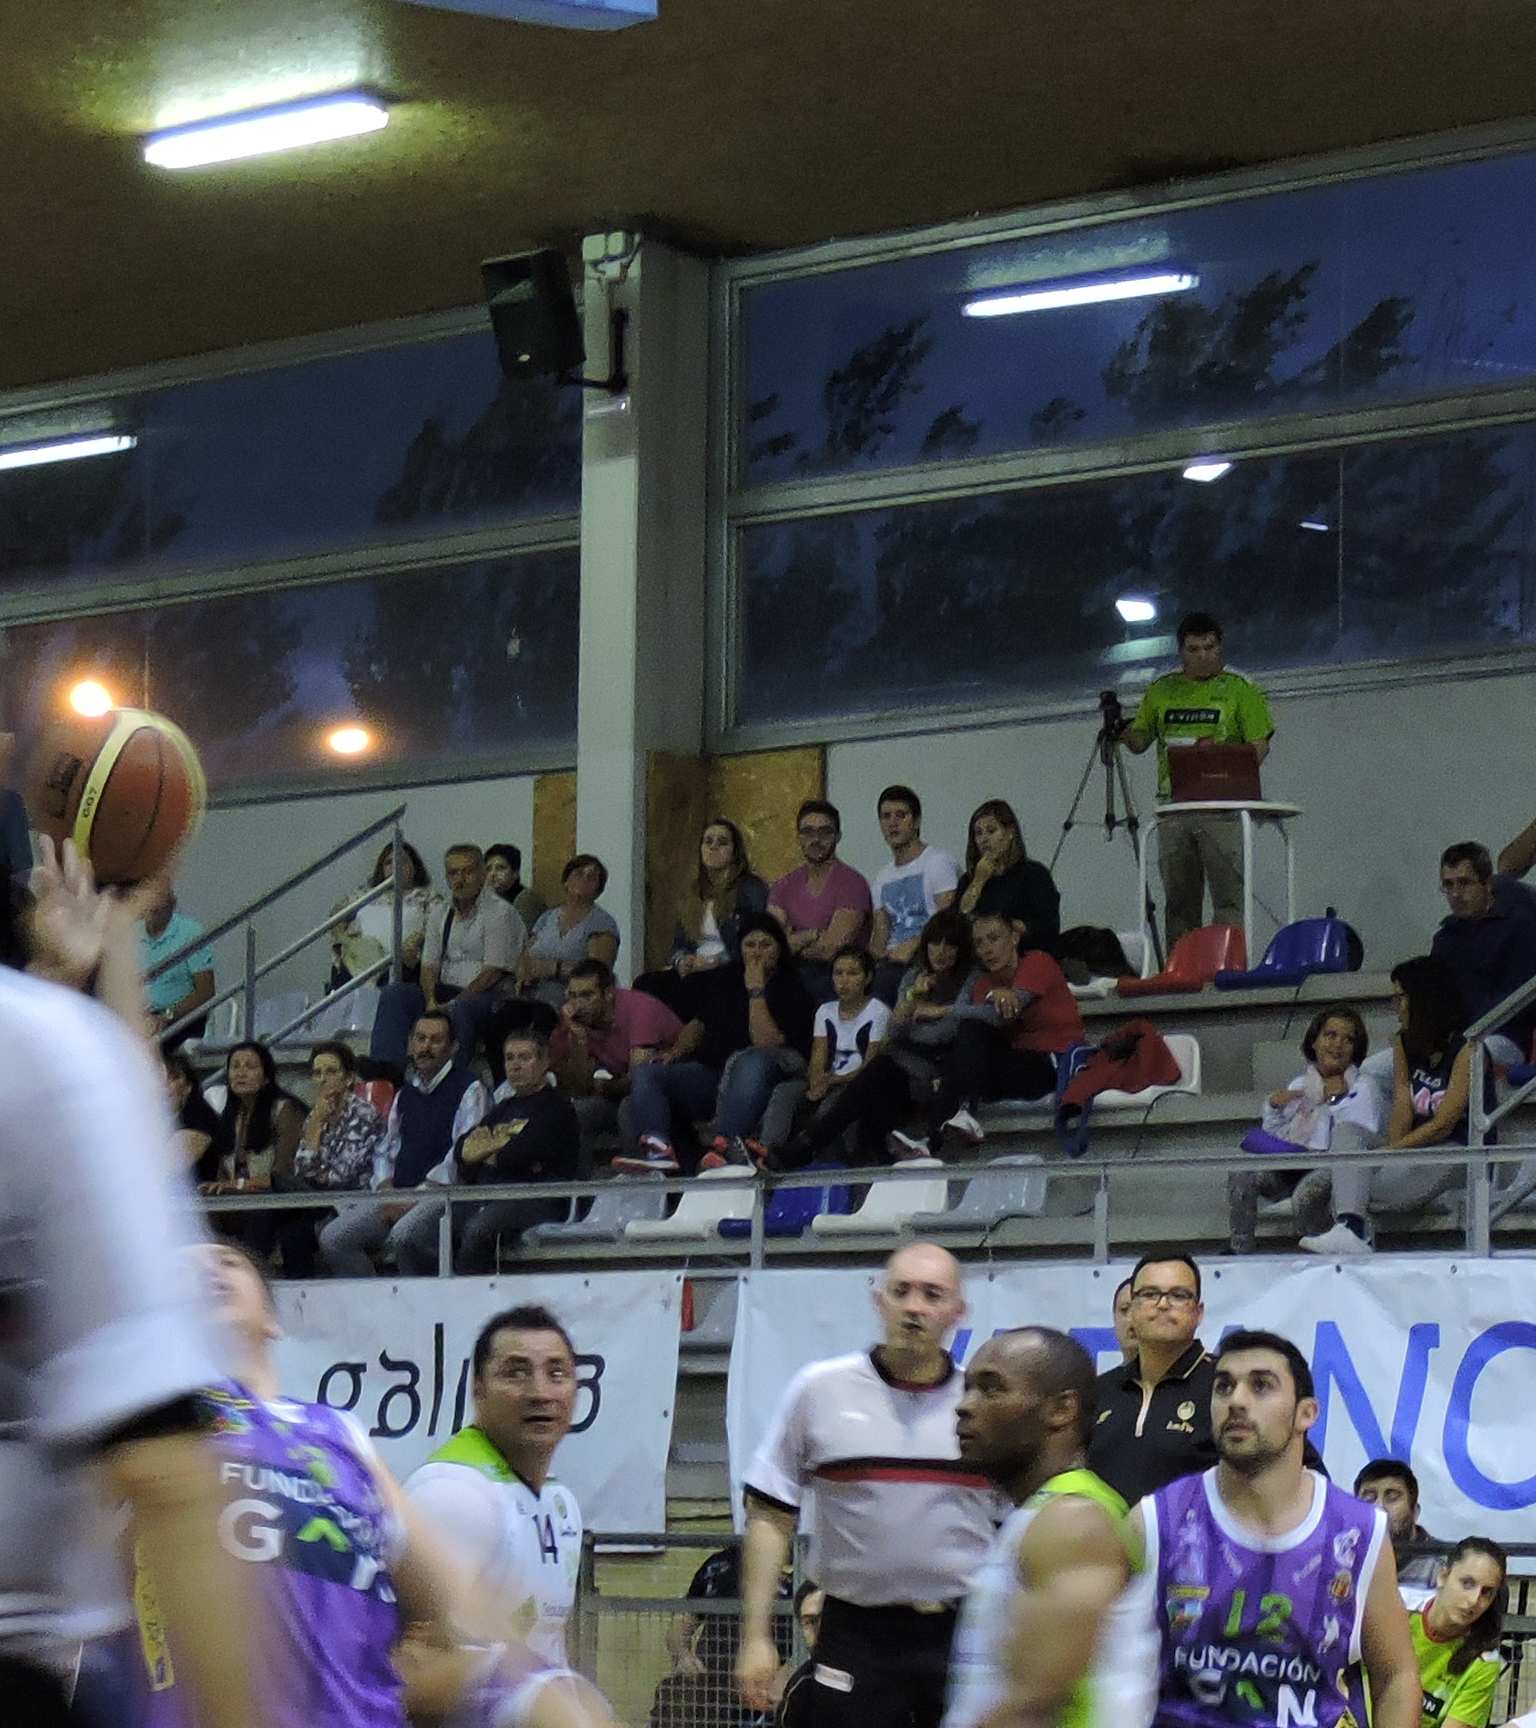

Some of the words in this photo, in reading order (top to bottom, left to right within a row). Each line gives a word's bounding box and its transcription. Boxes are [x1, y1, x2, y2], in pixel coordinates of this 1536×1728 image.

[217, 1498, 284, 1563] G
[531, 1512, 559, 1565] 14
[1223, 1589, 1294, 1645] 12
[1174, 1644, 1322, 1684] FUNDACIÓN
